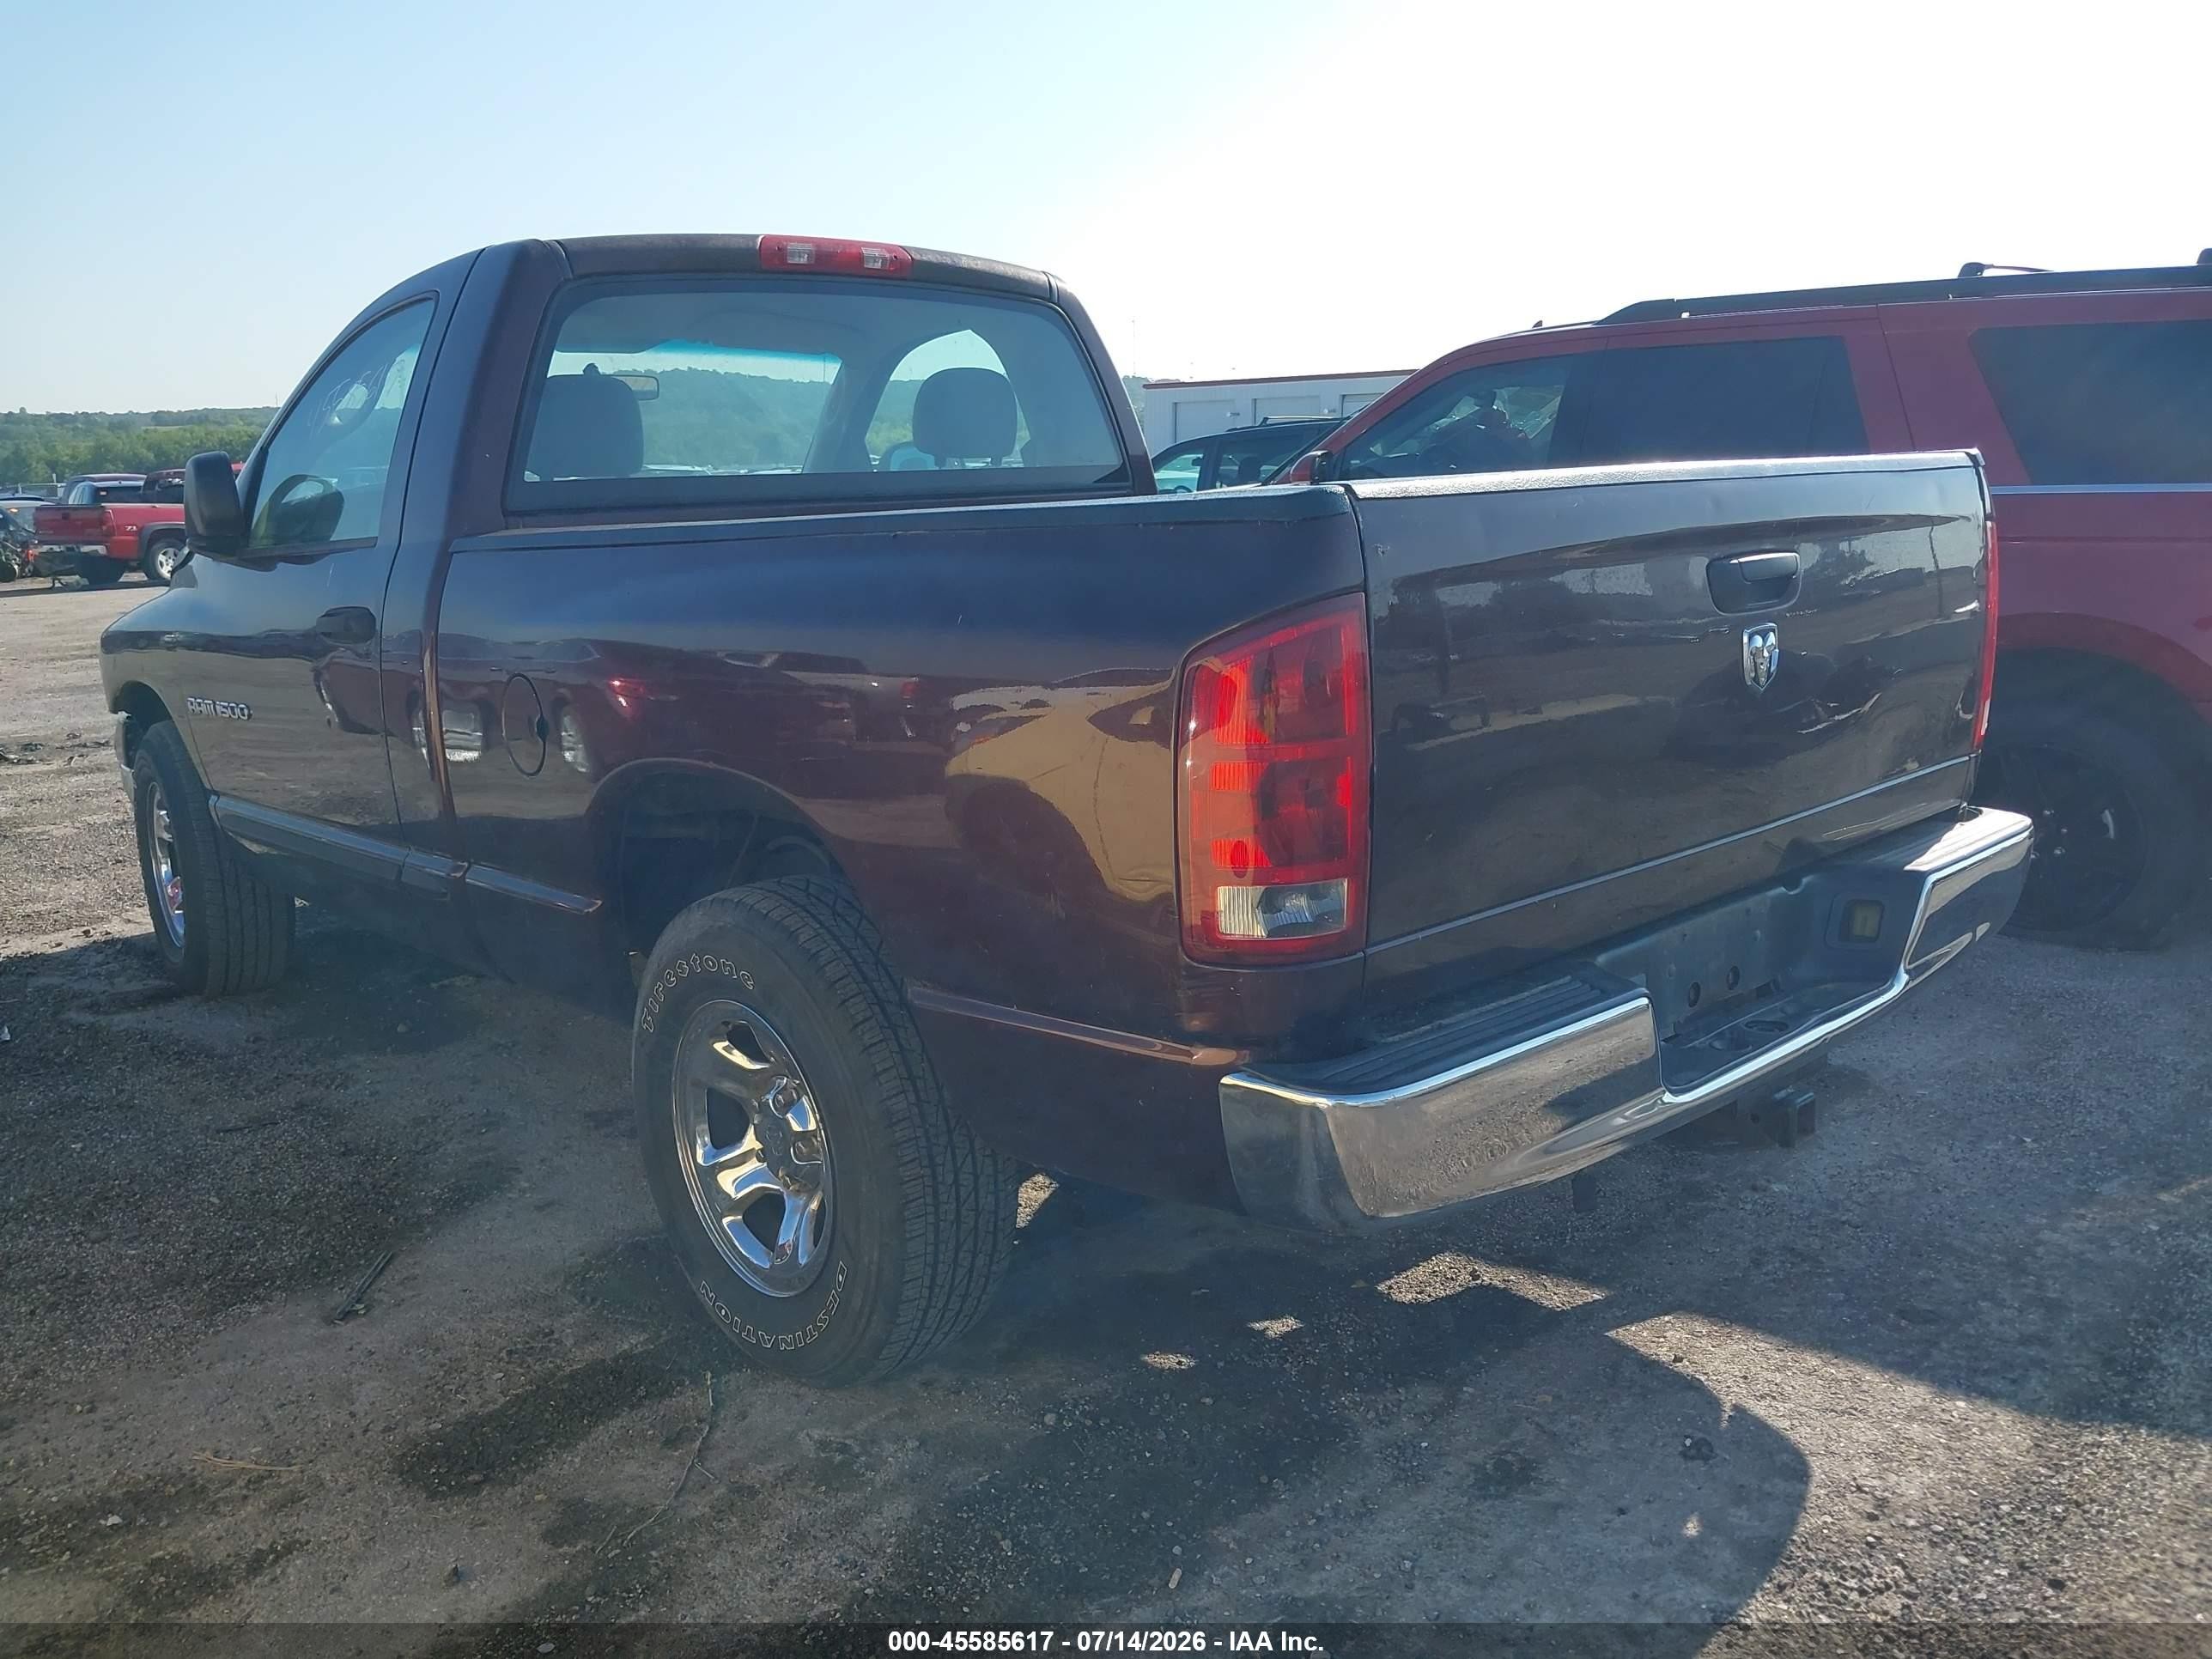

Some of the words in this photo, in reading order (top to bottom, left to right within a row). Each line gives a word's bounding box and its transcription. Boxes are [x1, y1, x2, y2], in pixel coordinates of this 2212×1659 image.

[216, 701, 249, 720] 1500
[641, 952, 756, 1032] Firestone
[700, 1260, 848, 1351] DESTINATION
